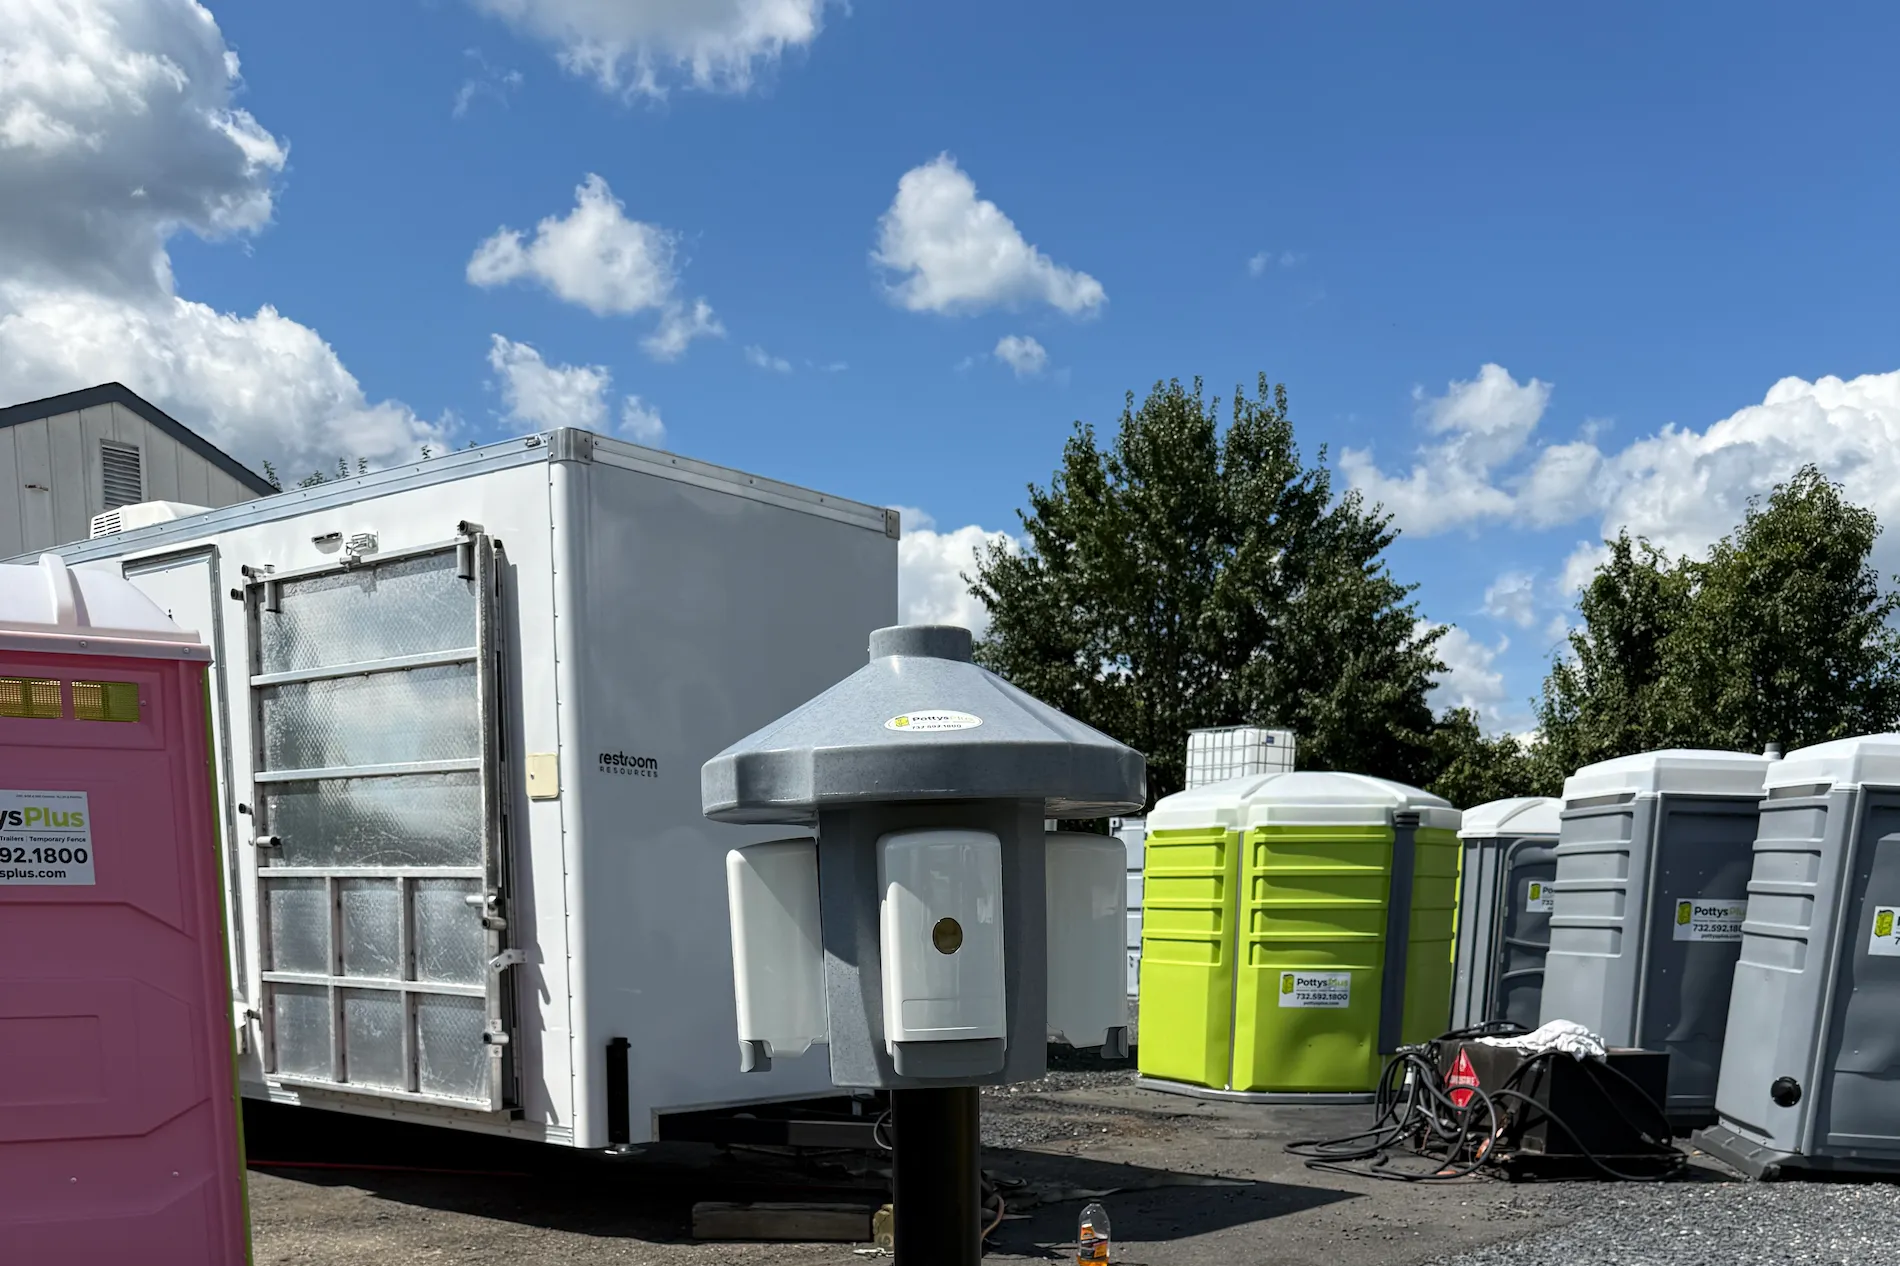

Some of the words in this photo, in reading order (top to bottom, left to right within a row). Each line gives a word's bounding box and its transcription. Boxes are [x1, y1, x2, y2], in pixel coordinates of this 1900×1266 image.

[599, 750, 658, 770] restroom
[599, 766, 658, 778] RESOURCES
[29, 836, 65, 844] Temporary
